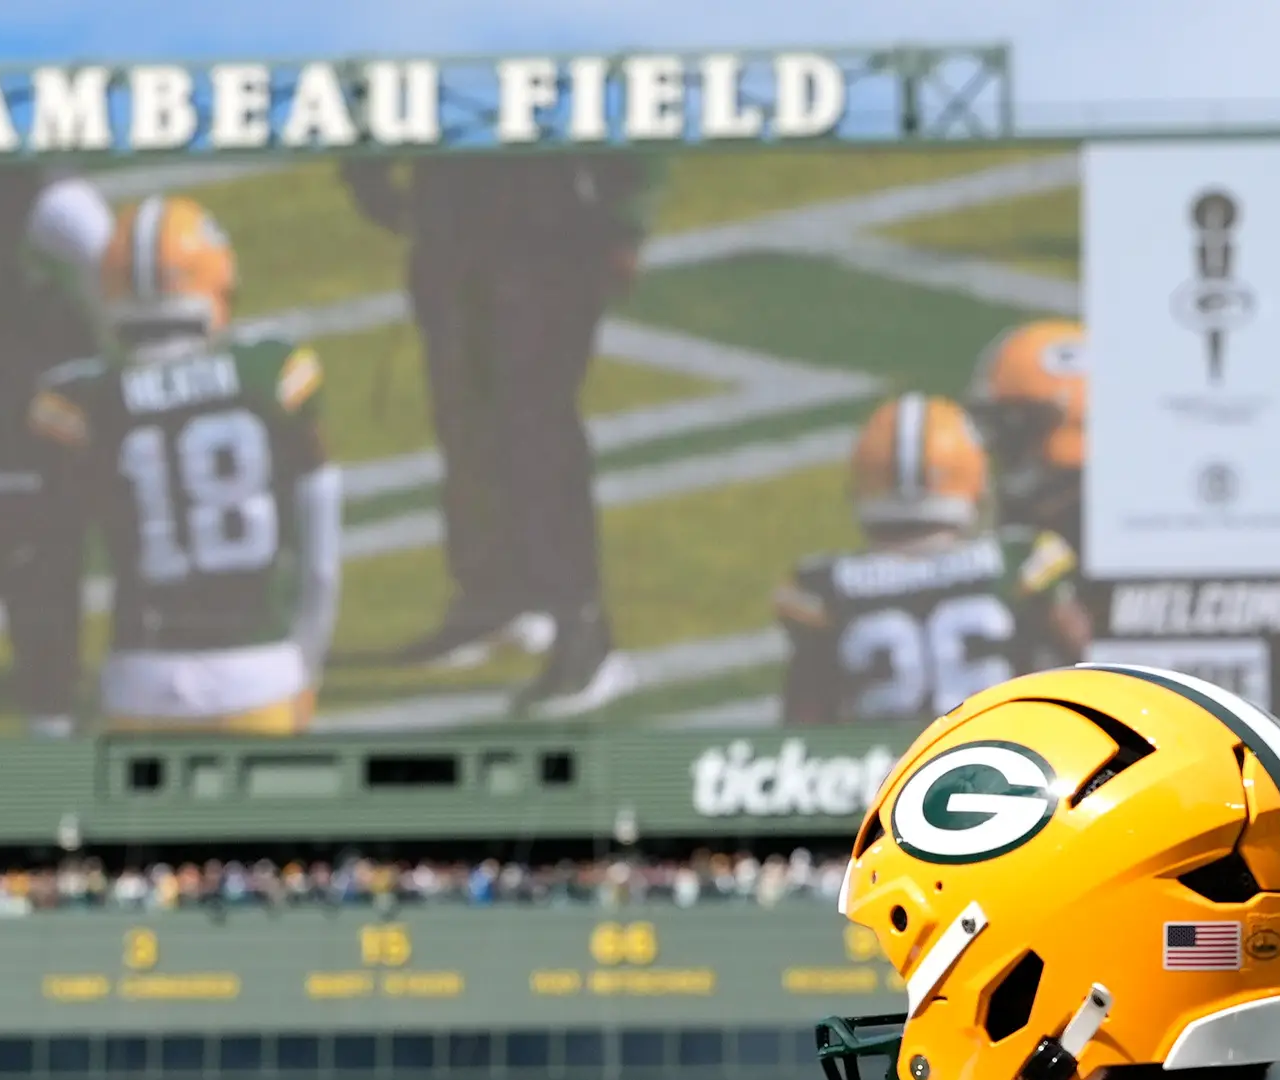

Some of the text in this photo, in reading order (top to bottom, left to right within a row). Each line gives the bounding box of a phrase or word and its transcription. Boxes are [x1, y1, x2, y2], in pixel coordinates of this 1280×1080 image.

[497, 52, 846, 140] FIELD
[122, 412, 278, 578] 18
[893, 744, 1057, 862] G
[125, 927, 157, 967] 3
[360, 925, 409, 965] 15
[591, 922, 656, 963] 66
